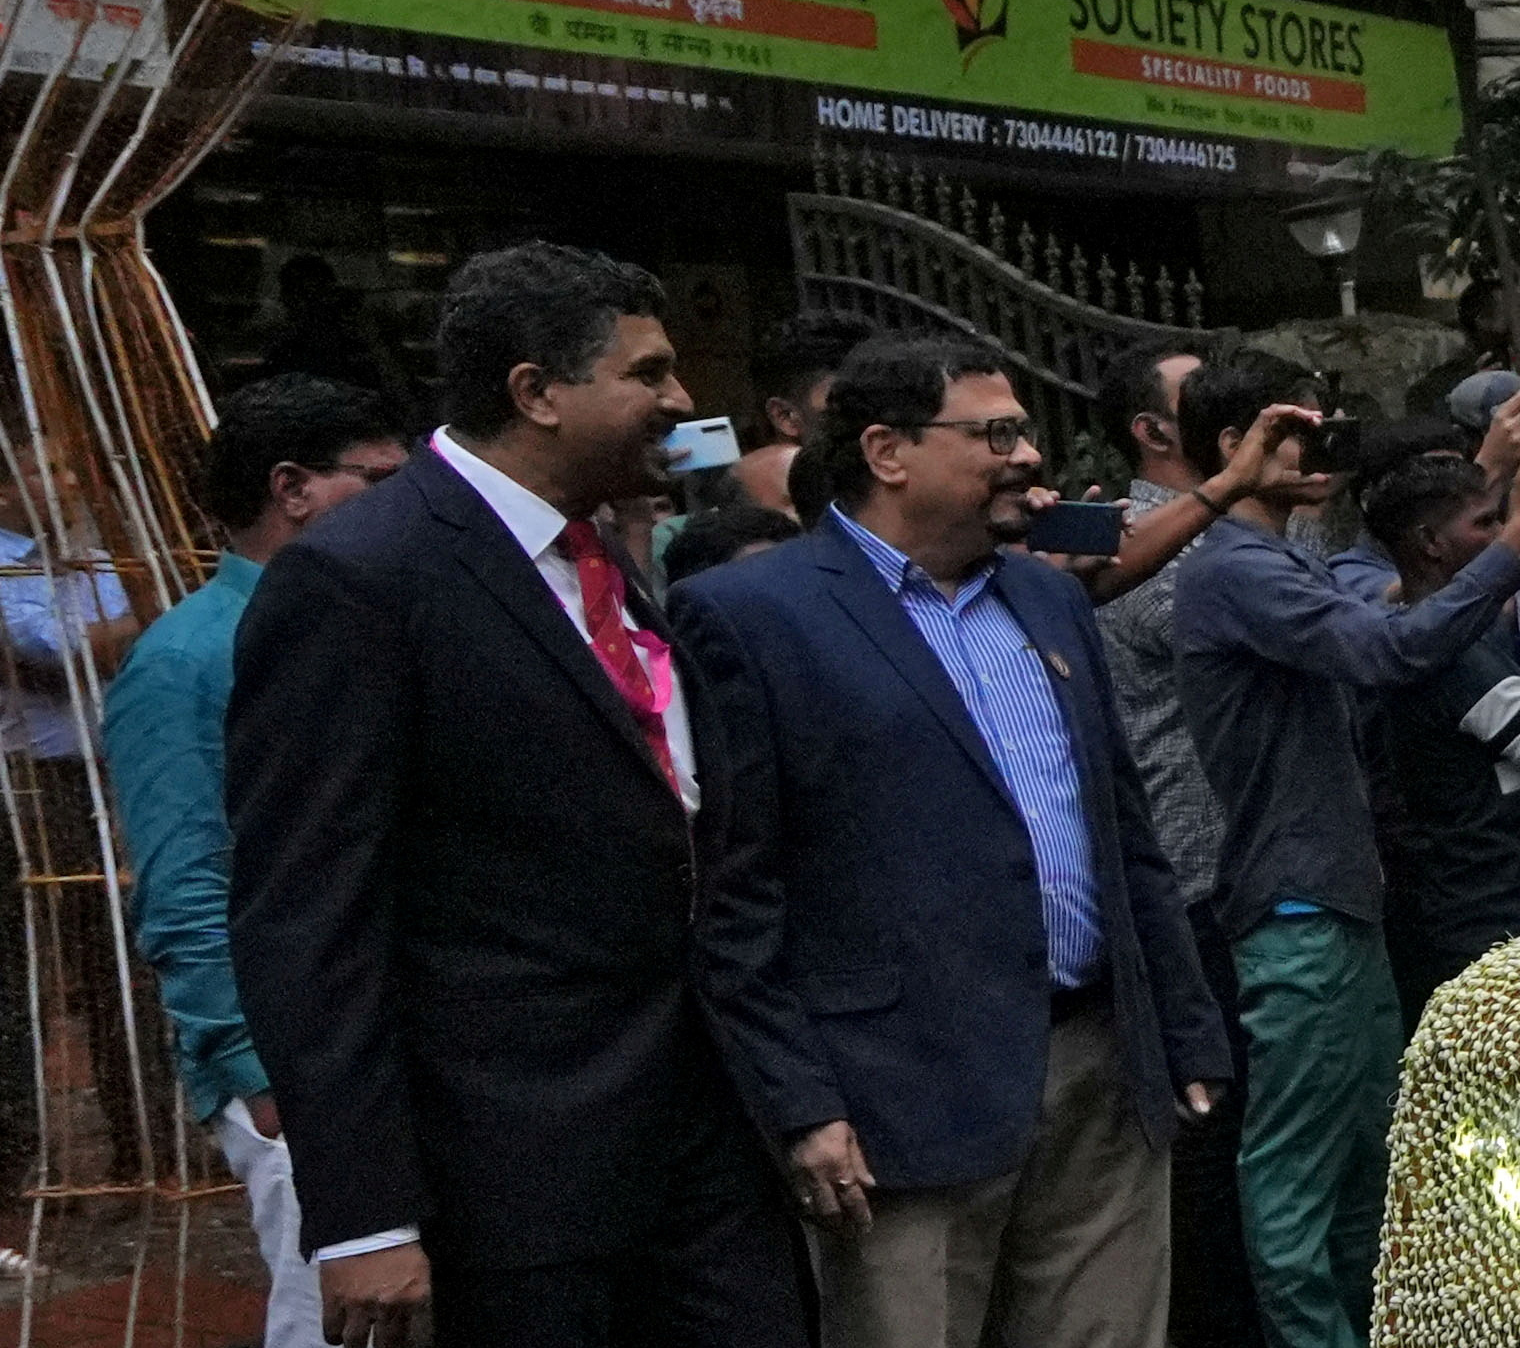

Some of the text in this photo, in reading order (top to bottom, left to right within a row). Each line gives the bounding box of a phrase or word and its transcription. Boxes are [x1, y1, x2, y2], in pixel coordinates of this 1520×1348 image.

[1239, 2, 1364, 76] STORES
[1140, 55, 1312, 102] SPECIALITY FOODS
[817, 96, 886, 133] HOME
[893, 105, 986, 143] DELIVERY
[1004, 119, 1119, 159] 7304446122
[1135, 135, 1237, 171] 7304446125
